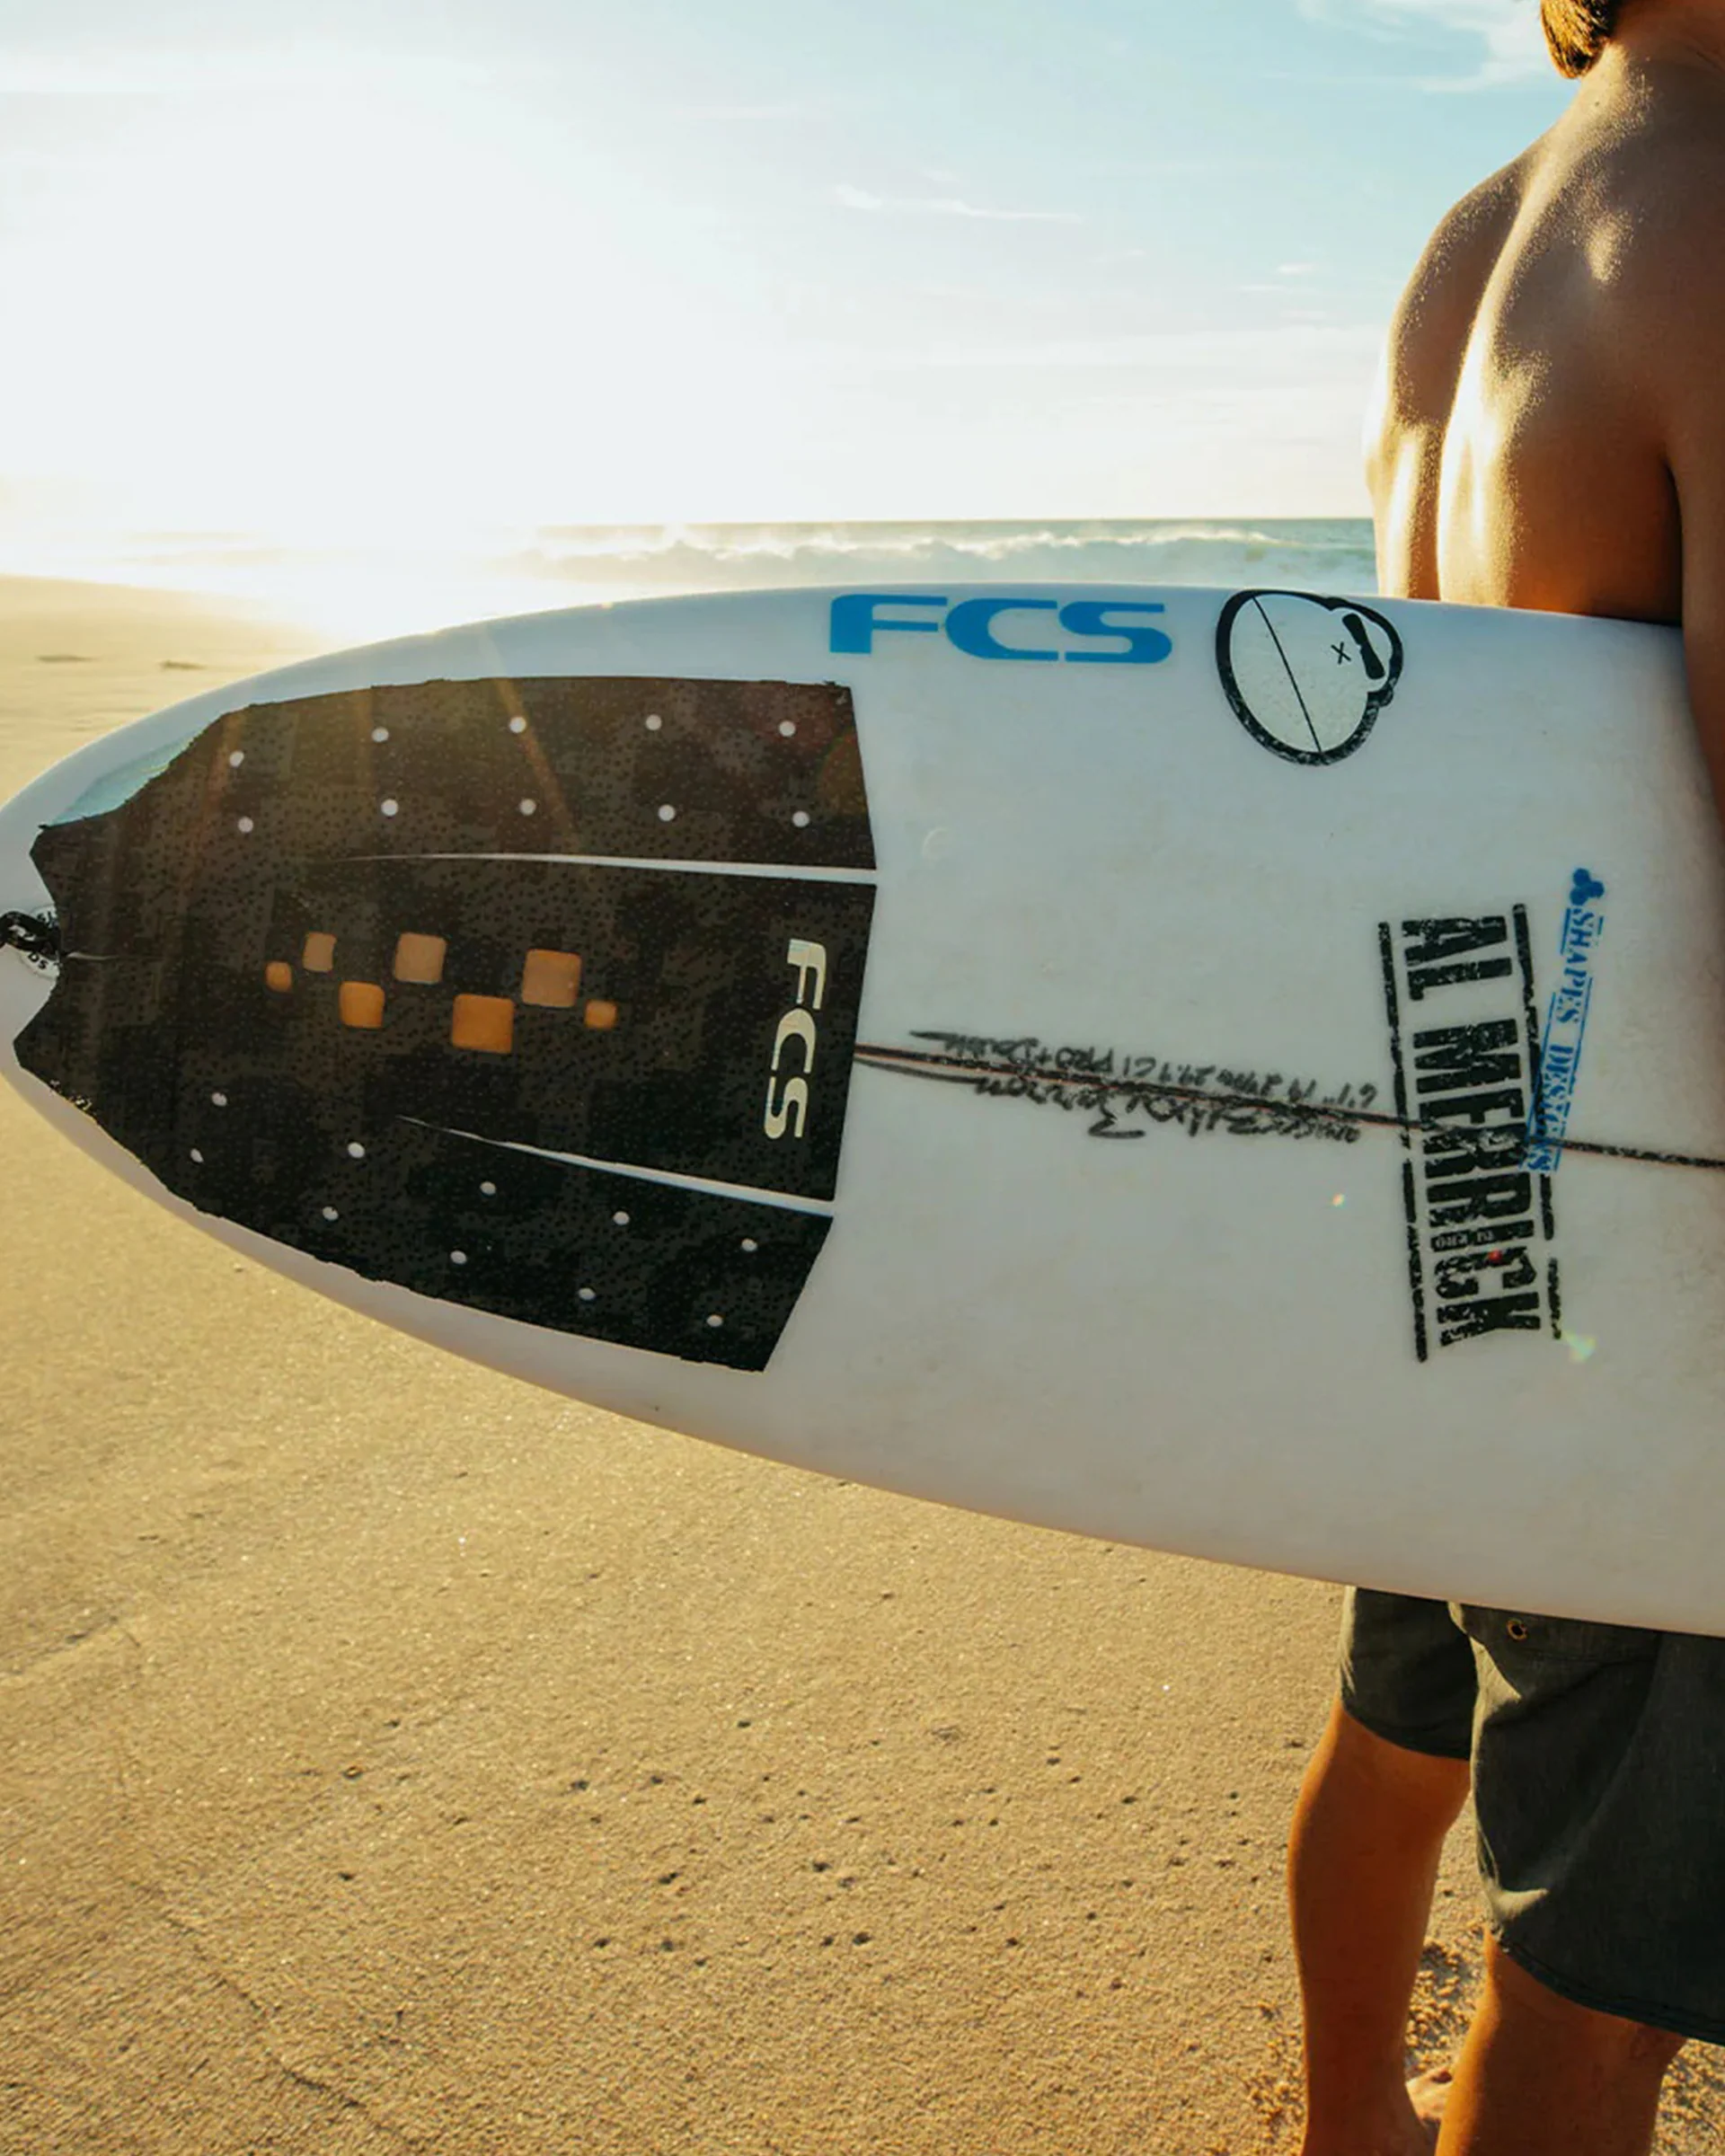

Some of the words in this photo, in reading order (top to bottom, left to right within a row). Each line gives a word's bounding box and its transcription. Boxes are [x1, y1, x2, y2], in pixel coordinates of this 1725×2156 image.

[830, 594, 1172, 664] FCS
[1402, 915, 1512, 1001] AL
[1555, 909, 1600, 1024] SHAPES
[765, 939, 827, 1138] FCS
[1526, 1044, 1579, 1171] DESIGNS
[1412, 1018, 1541, 1347] MERRICK
